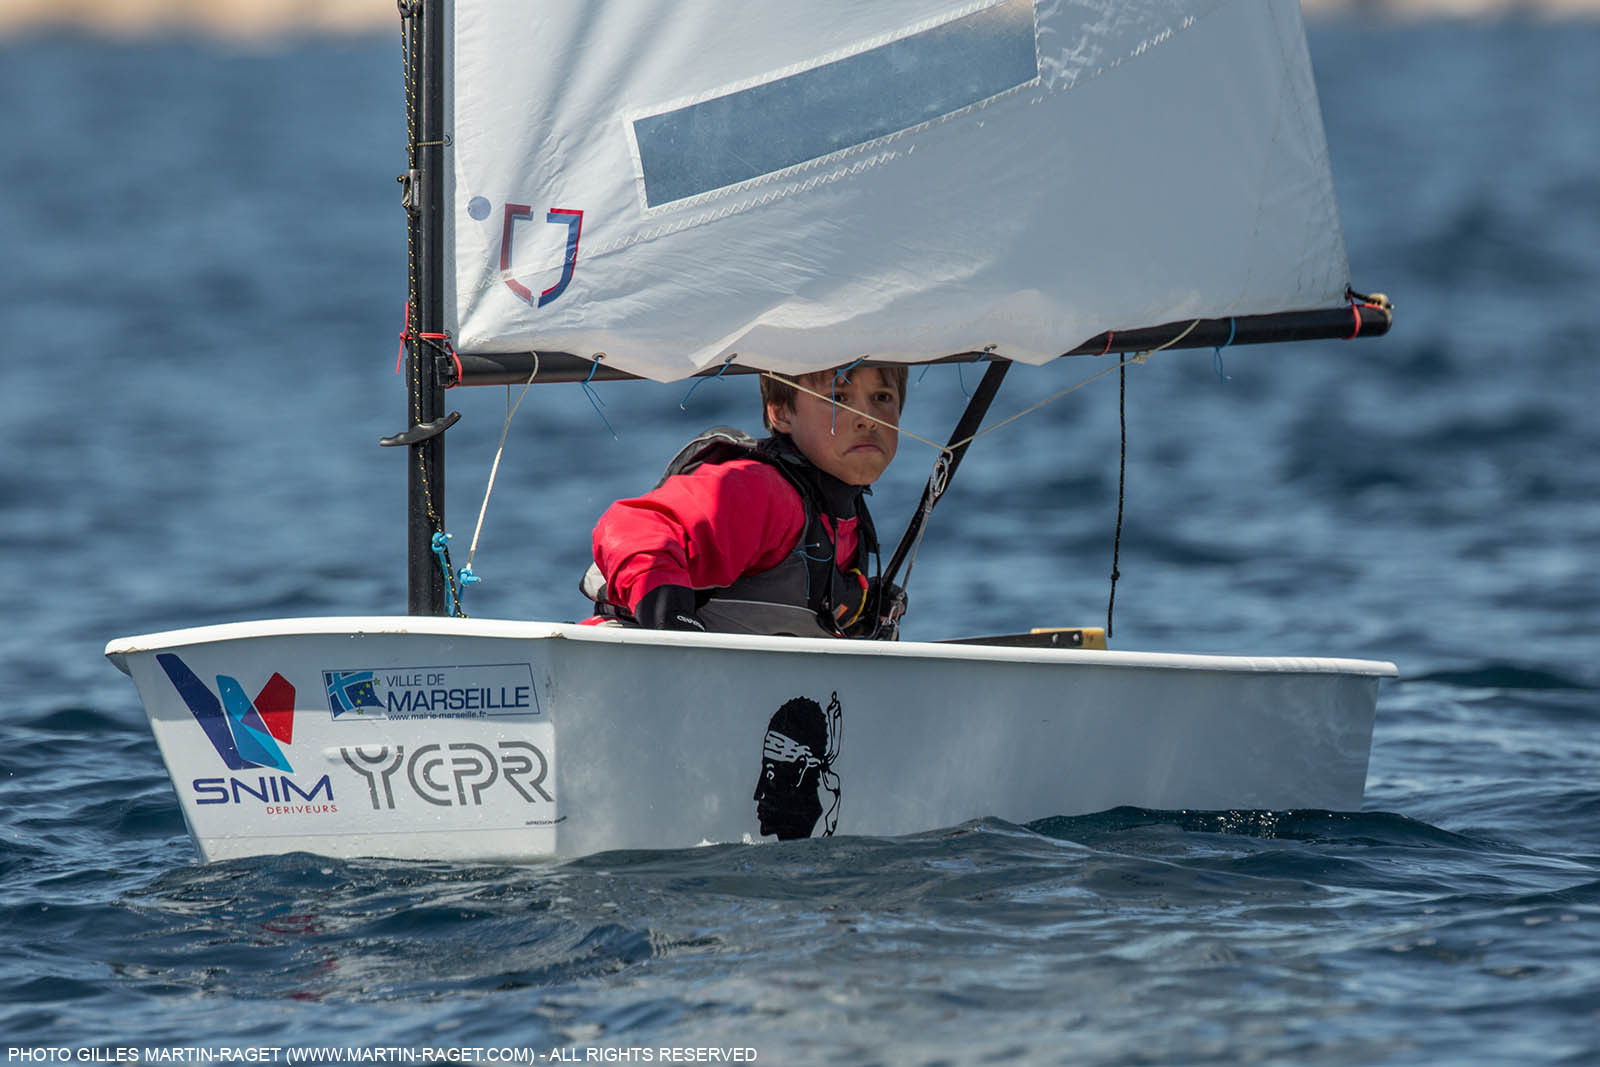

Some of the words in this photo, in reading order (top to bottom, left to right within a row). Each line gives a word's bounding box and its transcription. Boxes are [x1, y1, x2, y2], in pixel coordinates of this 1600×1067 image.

[386, 674, 422, 687] VILLE
[426, 673, 445, 686] DE
[387, 686, 530, 712] MARSEILLE
[388, 710, 486, 720] www.mairie-marseille.fr
[340, 741, 555, 810] YCPR
[193, 774, 335, 805] SNIM
[266, 804, 338, 815] DERIVEURS
